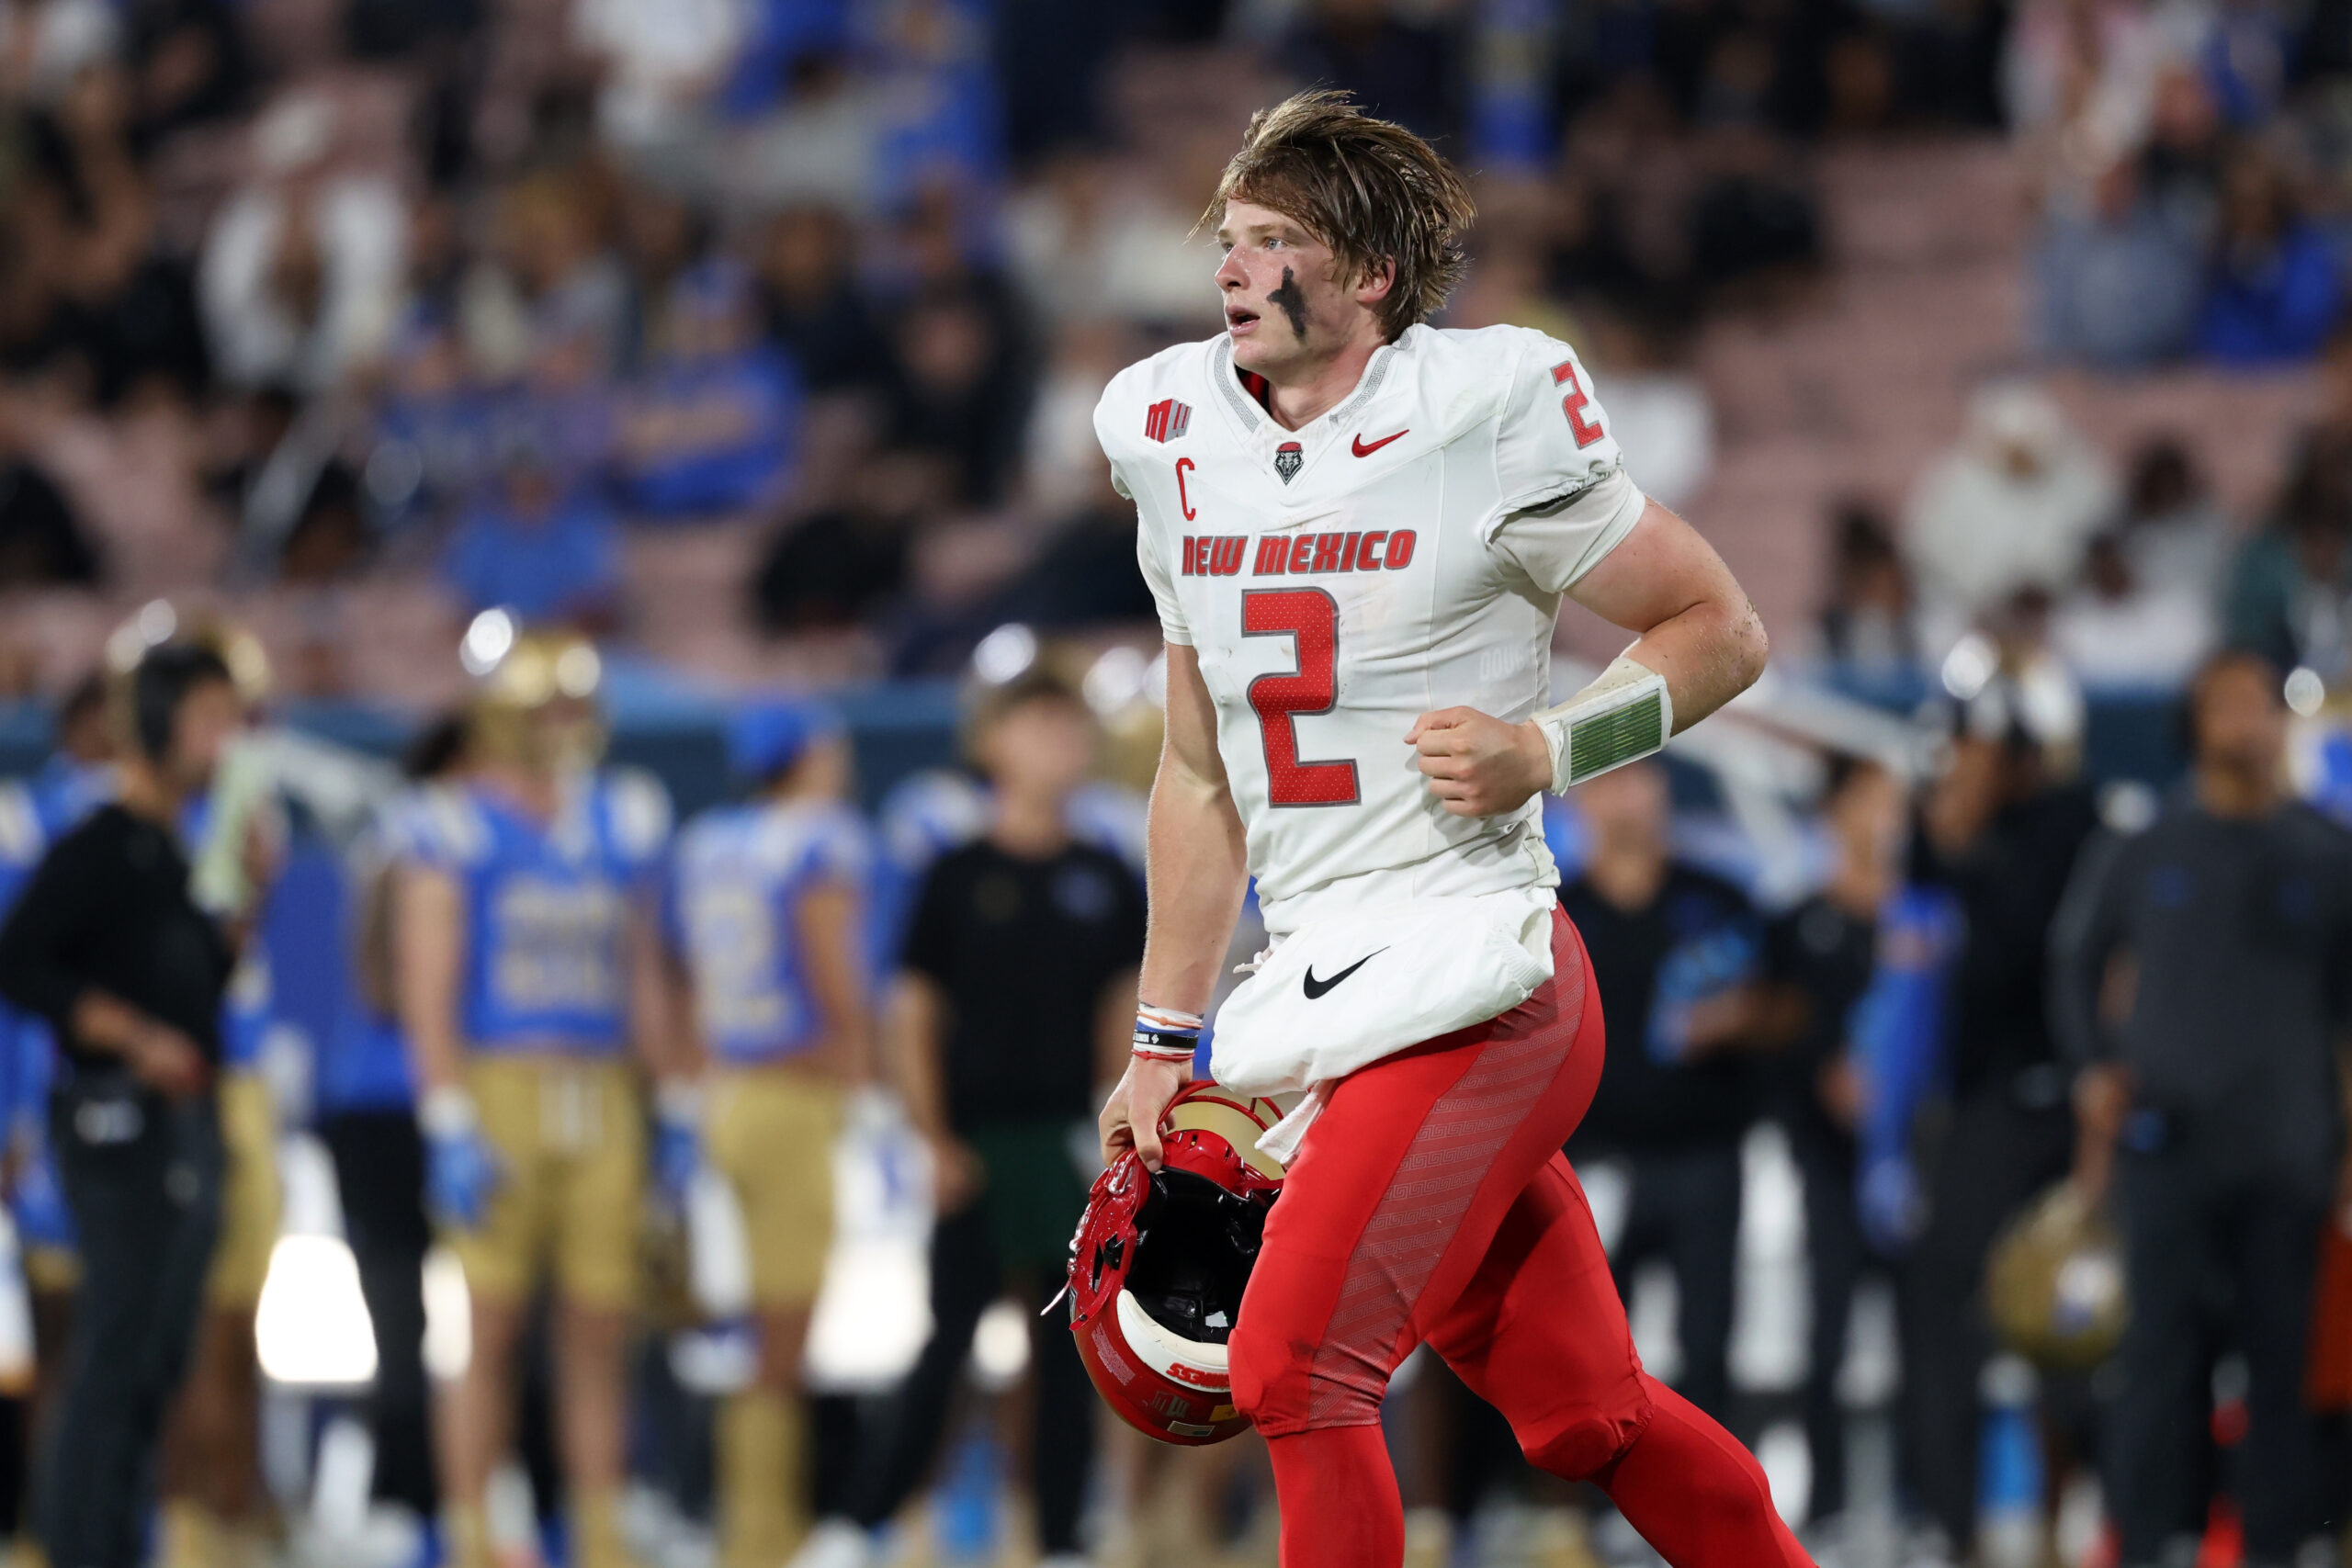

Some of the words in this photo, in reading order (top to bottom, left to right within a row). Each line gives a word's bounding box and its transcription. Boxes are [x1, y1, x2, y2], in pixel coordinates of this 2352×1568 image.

[1550, 360, 1605, 450] 2
[1176, 457, 1196, 521] C
[1182, 536, 1249, 576] NEW
[1252, 529, 1417, 576] MEXICO
[1241, 586, 1362, 809] 2
